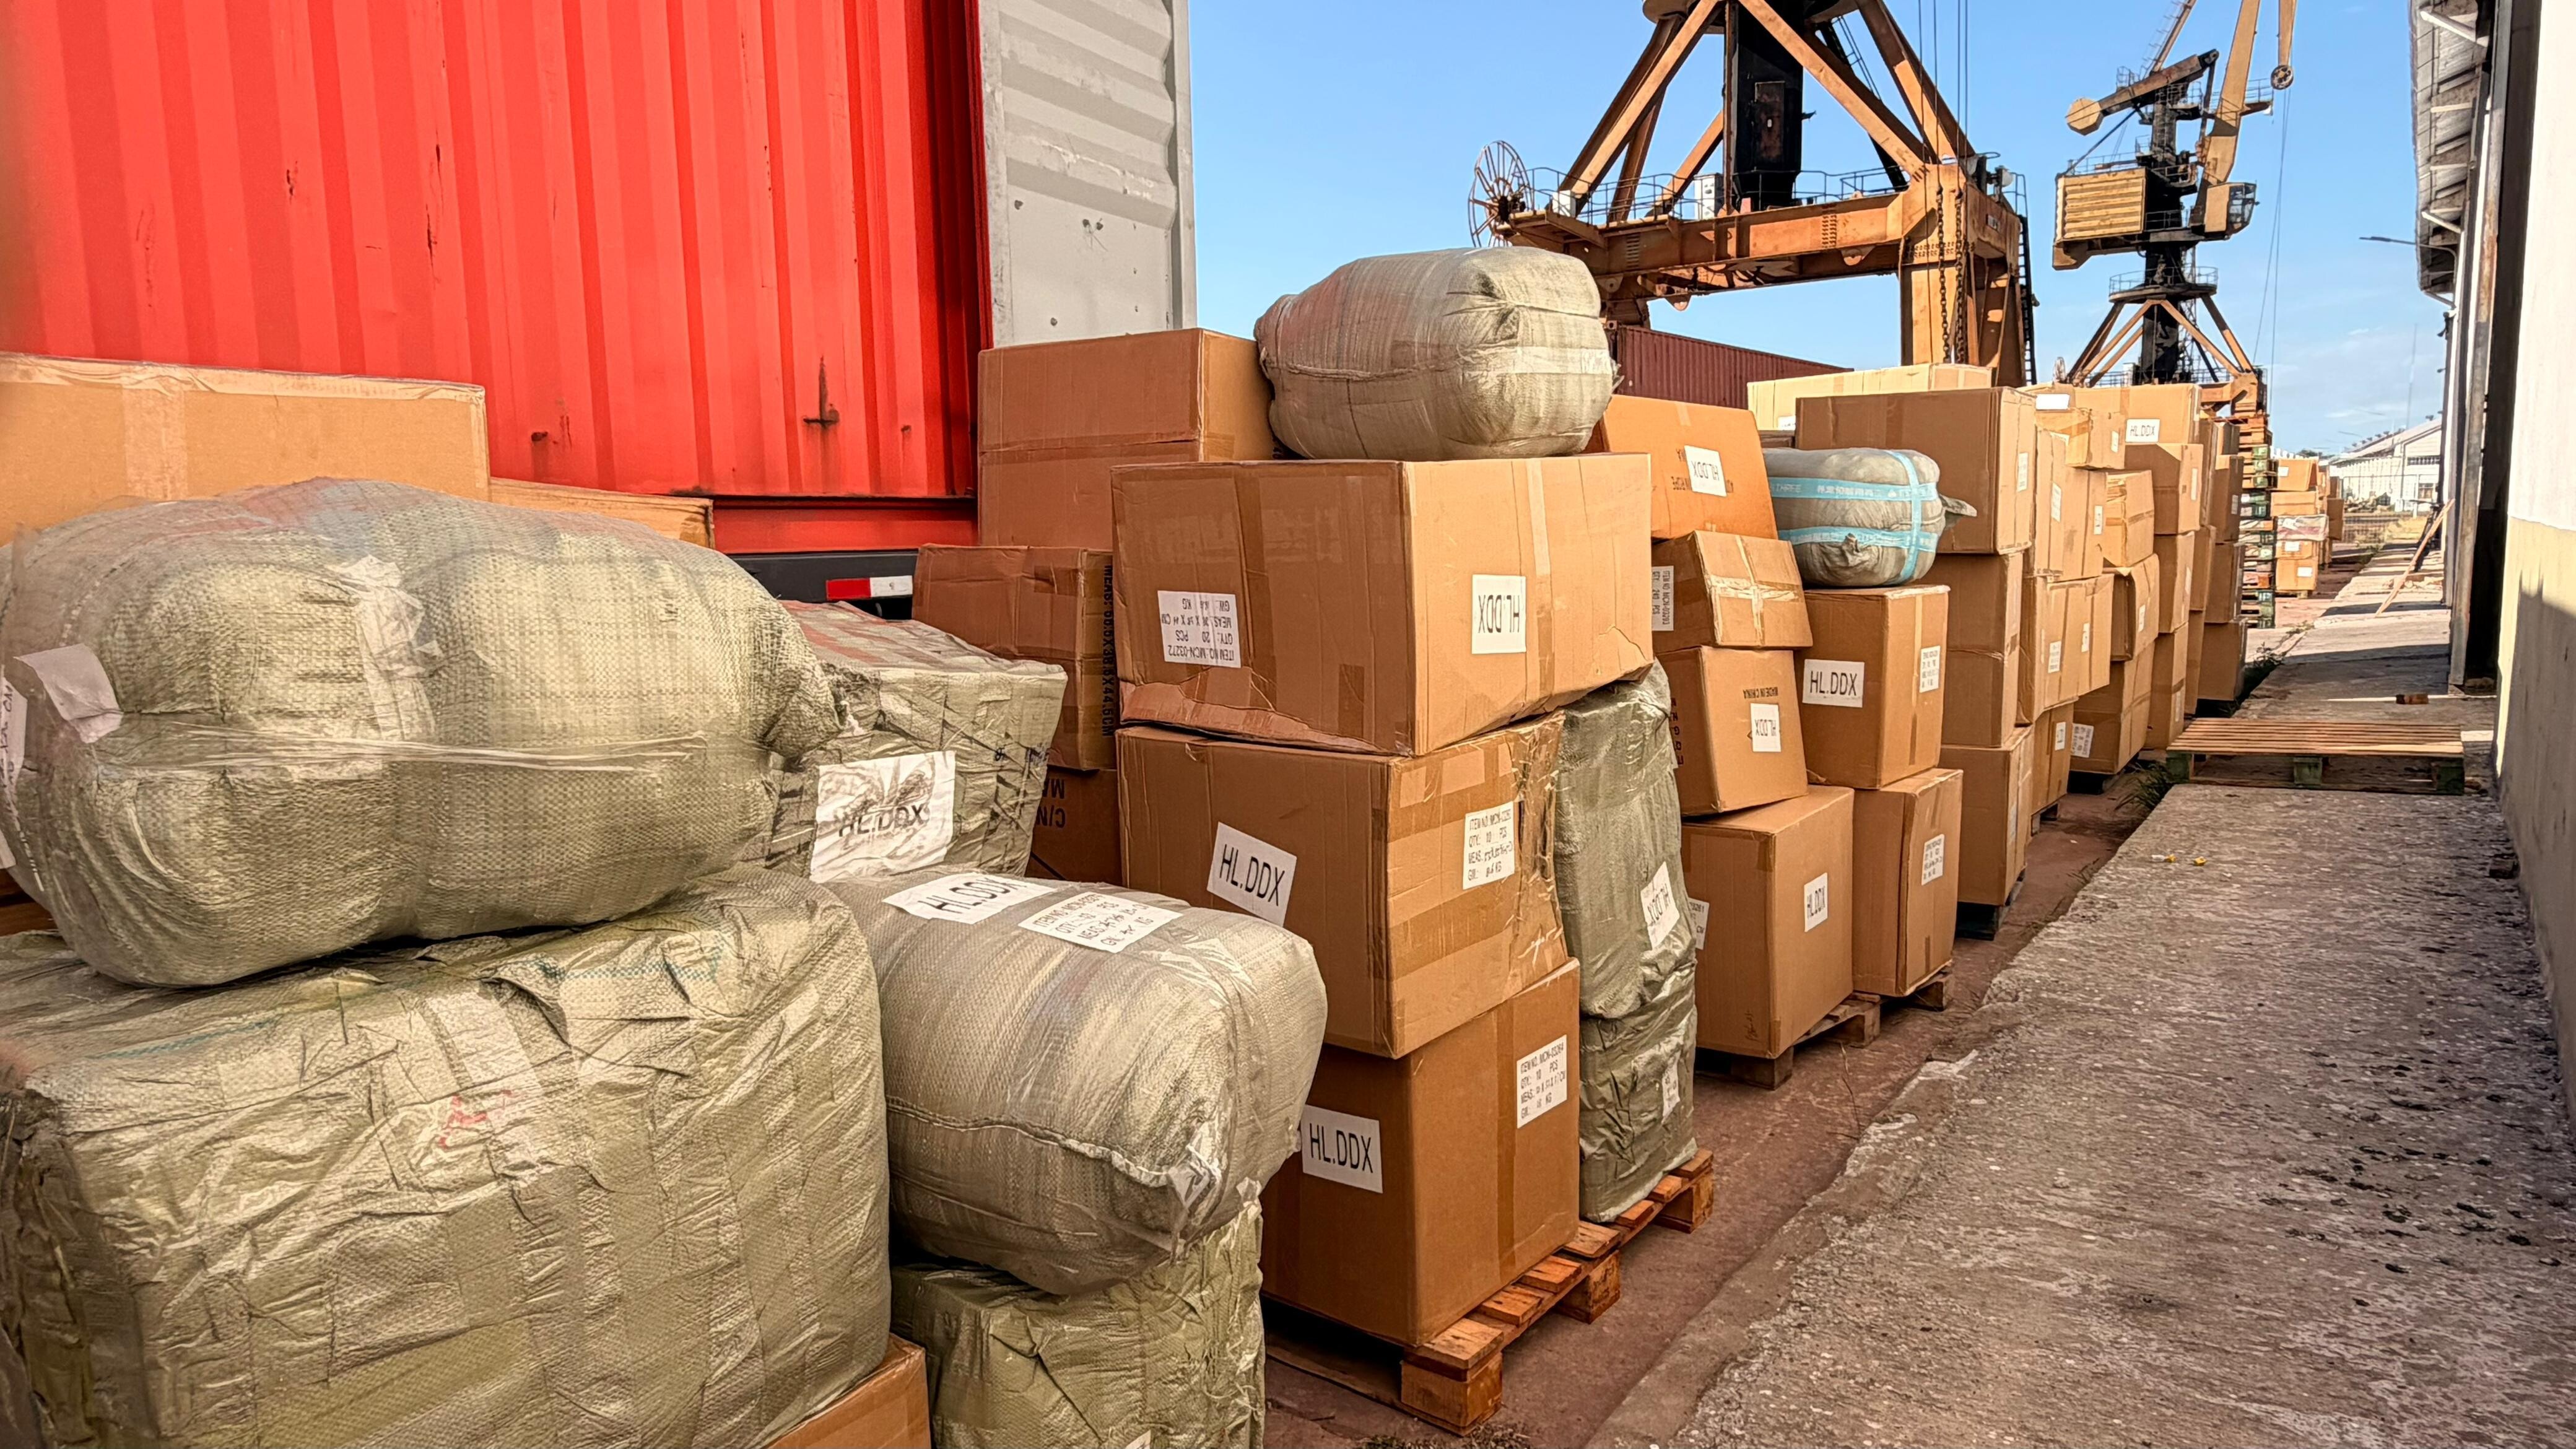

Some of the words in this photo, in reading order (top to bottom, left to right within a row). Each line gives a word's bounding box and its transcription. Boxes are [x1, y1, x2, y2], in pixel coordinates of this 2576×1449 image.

[1182, 598, 1192, 610] KG
[1175, 630, 1189, 642] PCS
[1202, 631, 1210, 643] 20
[1809, 670, 1858, 697] HL.DDX
[1219, 843, 1286, 907] HL.DDX
[1310, 1123, 1373, 1173] HL.DDX
